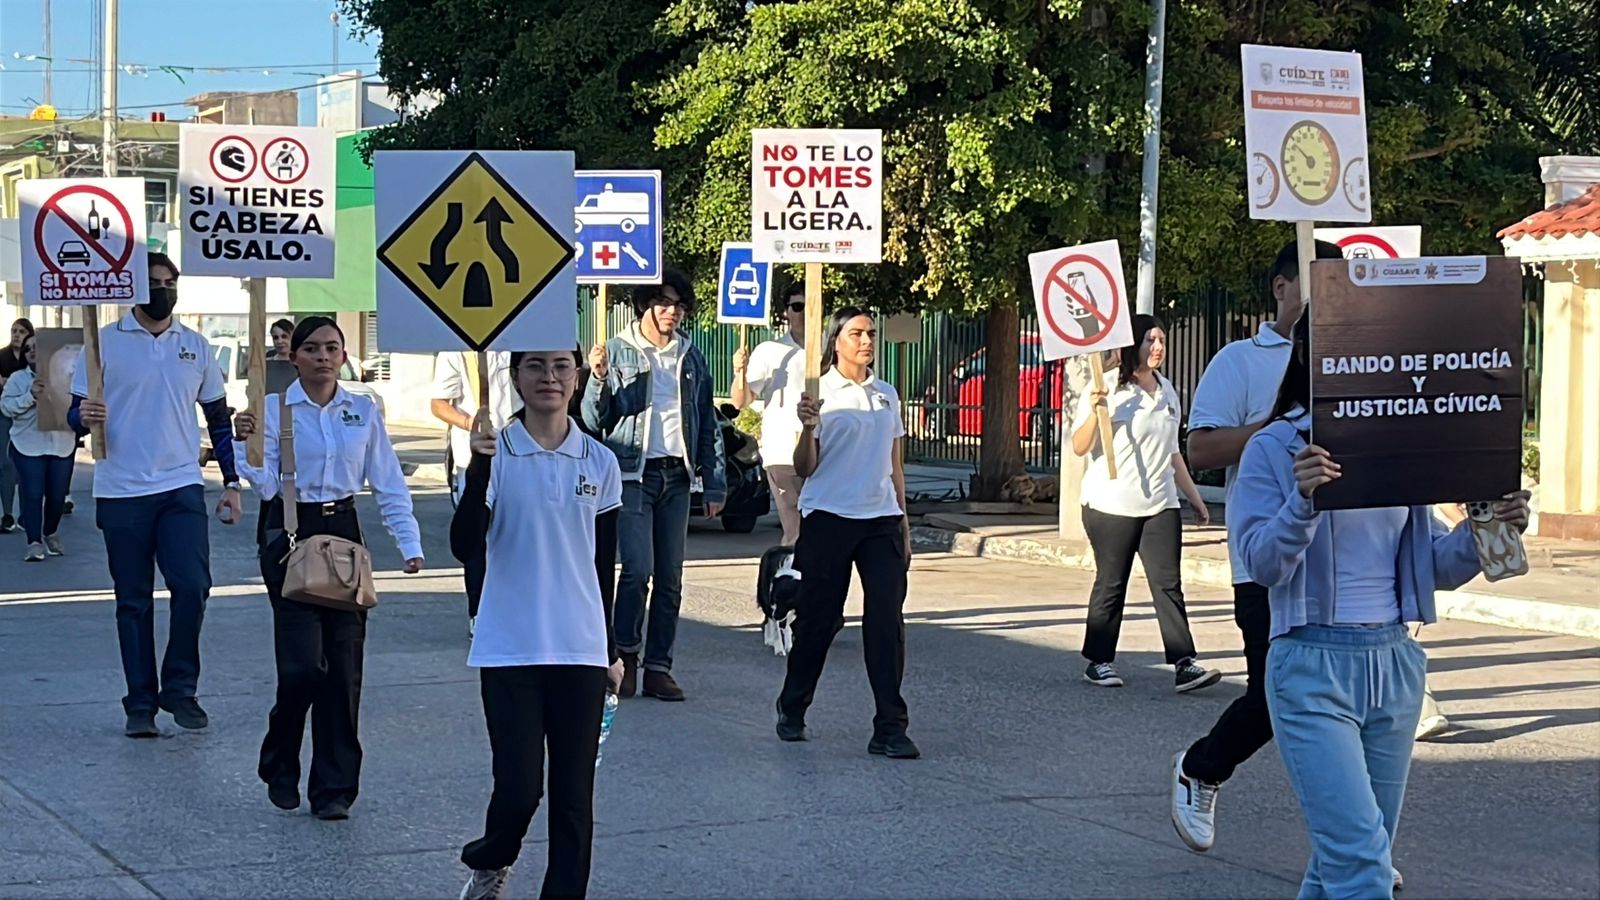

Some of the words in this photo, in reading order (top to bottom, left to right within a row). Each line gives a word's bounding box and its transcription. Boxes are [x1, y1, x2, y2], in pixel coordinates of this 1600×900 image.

[764, 145, 798, 162] NO
[806, 146, 835, 162] TE
[844, 146, 874, 162] LO
[764, 166, 873, 188] TOMES
[189, 187, 214, 206] SI
[225, 188, 324, 208] TIENES
[787, 190, 806, 209] A
[816, 190, 850, 209] LA
[190, 210, 324, 235] CABEZA
[764, 212, 873, 231] LIGERA.
[202, 233, 312, 261] ÚSALO.
[41, 273, 60, 287] SI
[64, 272, 131, 287] TOMAS
[43, 288, 63, 299] NO
[67, 287, 132, 299] MANEJES
[1322, 355, 1395, 375] BANDO
[1401, 354, 1427, 372] DE
[1433, 348, 1512, 371] POLICÍA
[1412, 376, 1427, 393] Y
[1333, 397, 1429, 418] JUSTICIA
[1434, 393, 1502, 414] CÍVICA
